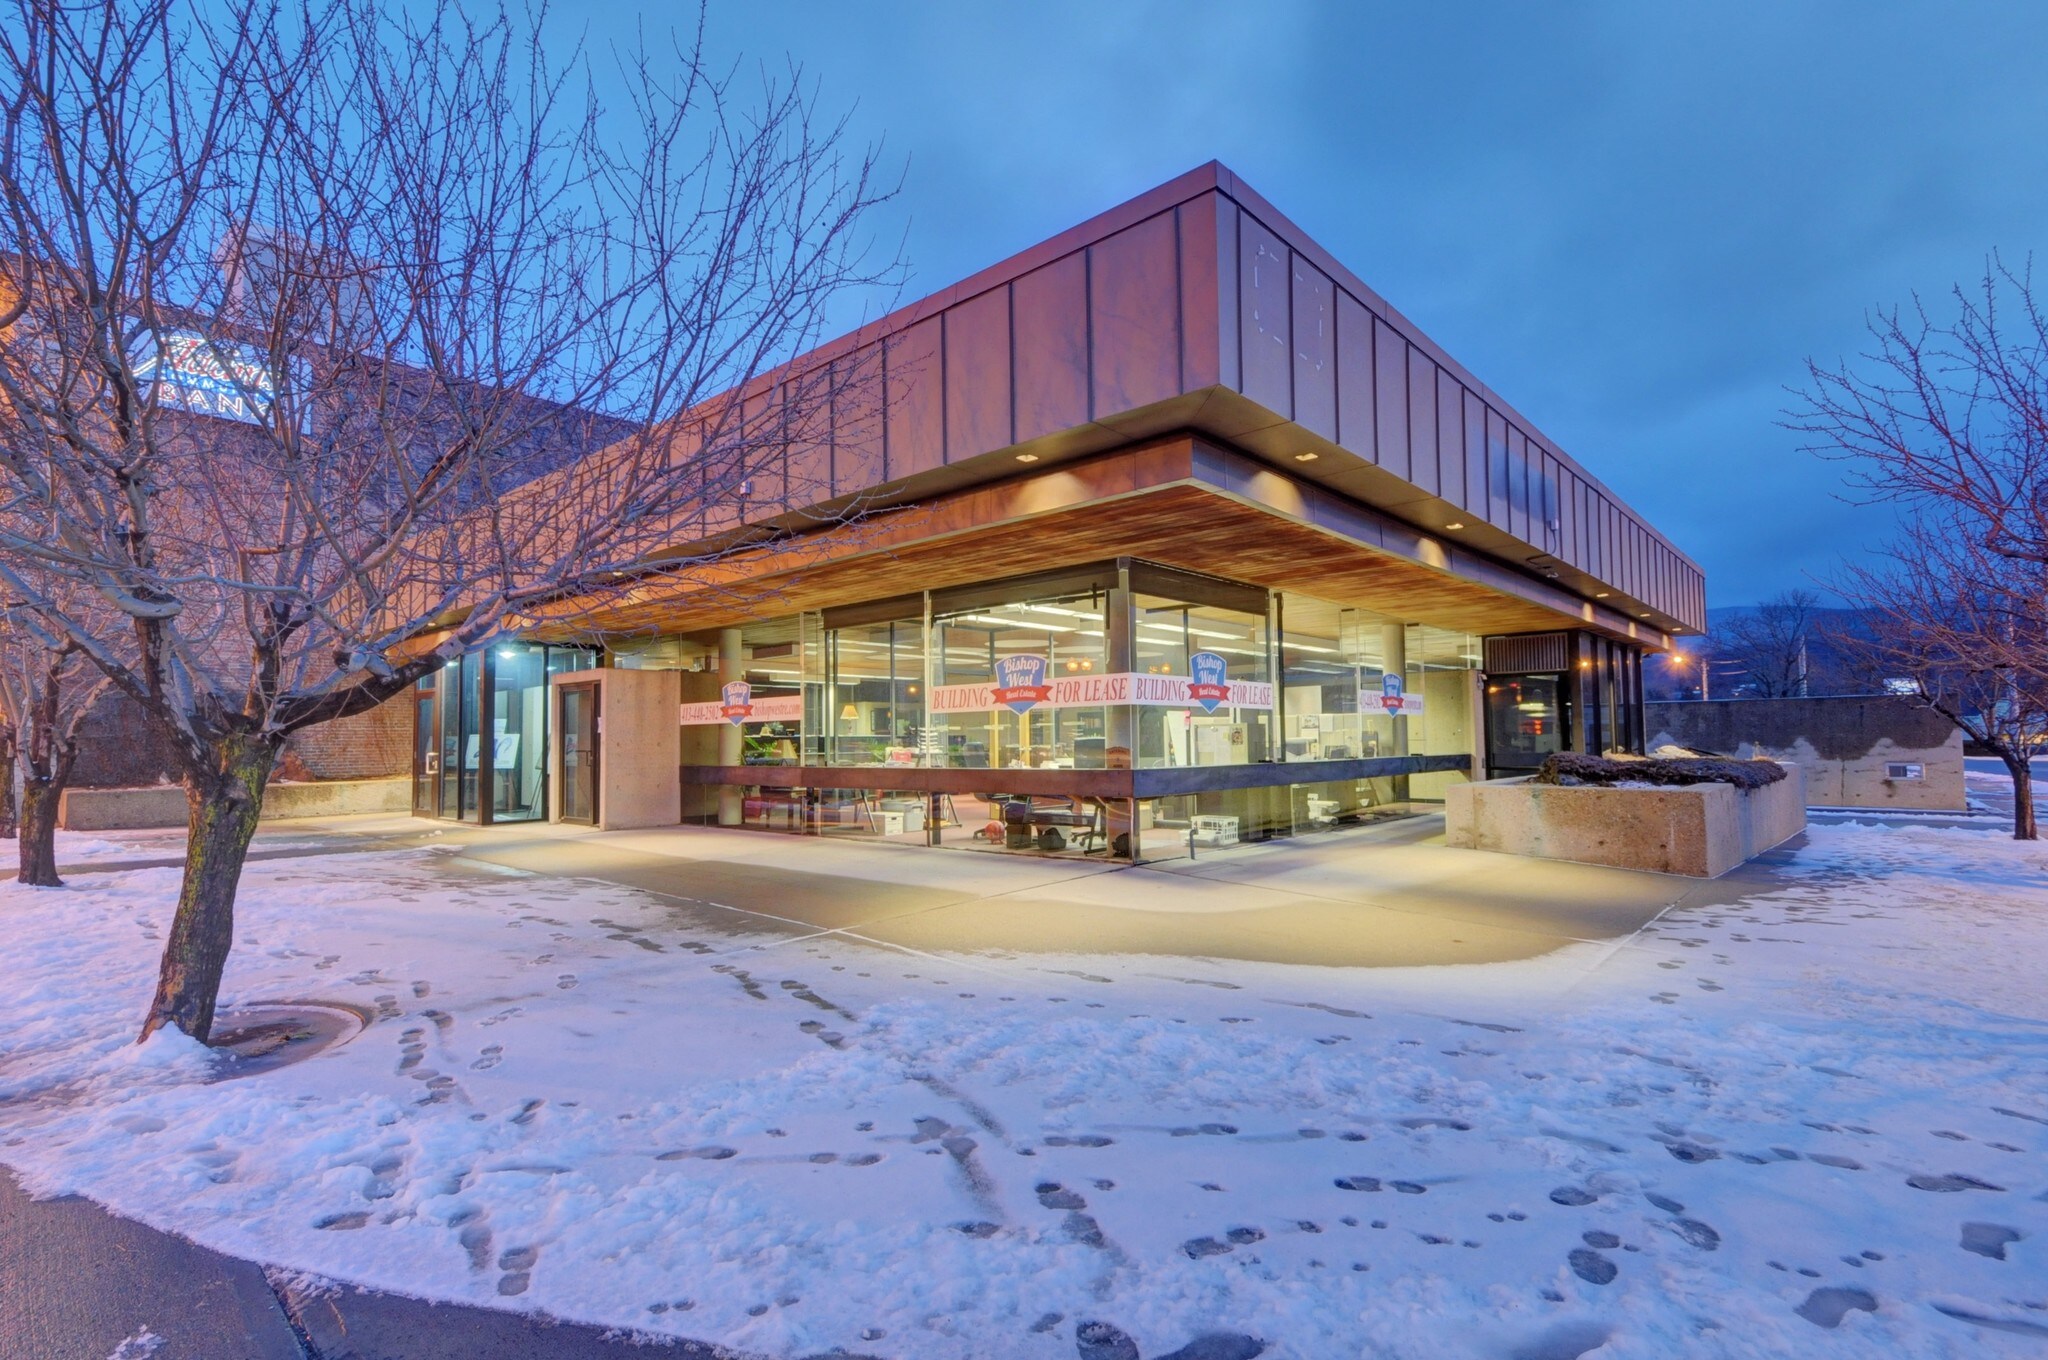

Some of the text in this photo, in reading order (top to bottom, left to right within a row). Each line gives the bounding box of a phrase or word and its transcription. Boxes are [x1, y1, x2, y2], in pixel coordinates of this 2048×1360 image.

[1003, 657, 1040, 674] Bishop
[1196, 655, 1222, 674] Bishop
[1006, 673, 1033, 687] West
[1198, 671, 1218, 684] West
[933, 677, 1128, 709] BUILDING FOR LEASE
[1136, 678, 1271, 705] BUILDING FOR LEASE
